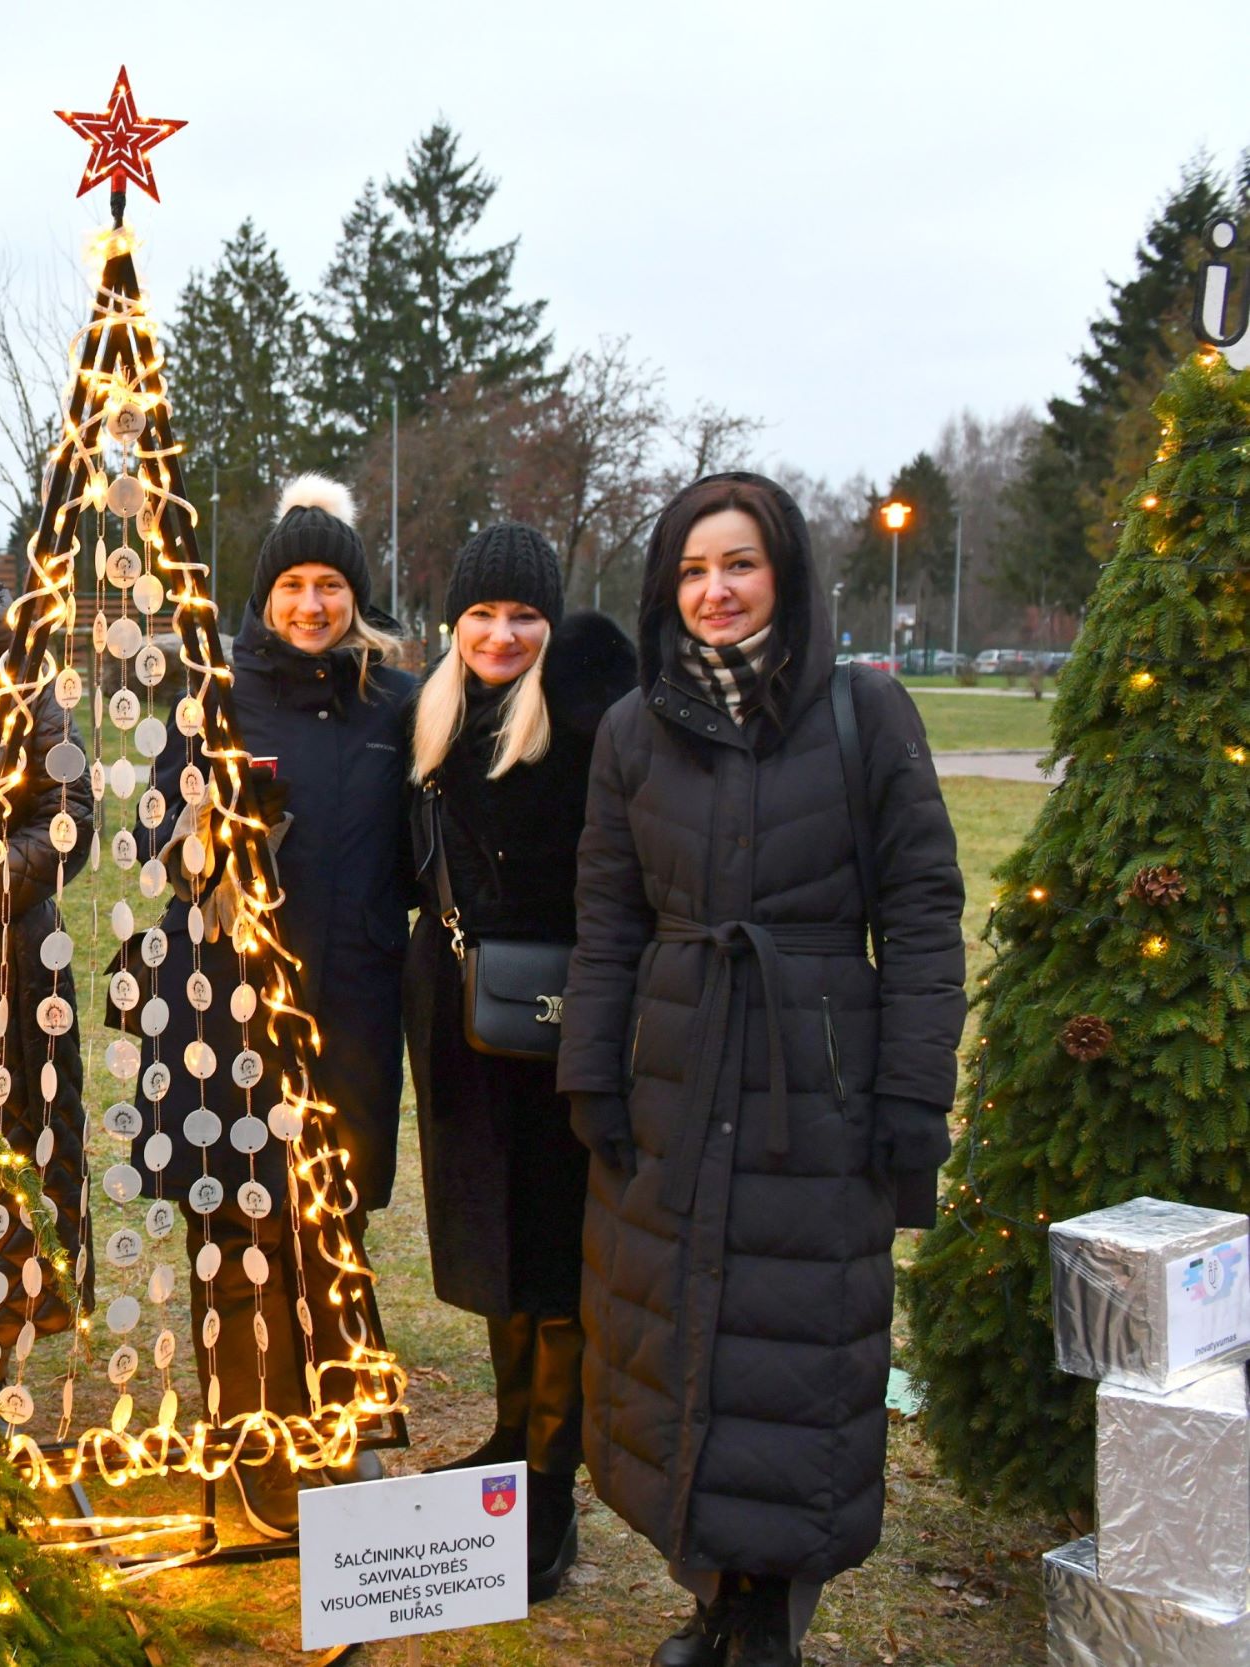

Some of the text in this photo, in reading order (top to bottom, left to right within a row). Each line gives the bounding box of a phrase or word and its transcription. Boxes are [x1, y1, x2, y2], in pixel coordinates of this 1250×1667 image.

[334, 1534, 495, 1569] ŠALČININKŲ RAJONO
[359, 1558, 468, 1586] SAVIVALDYBĖS
[321, 1574, 506, 1612] VISUOMENĖS SVEIKATOS
[390, 1603, 443, 1623] BIURAS
